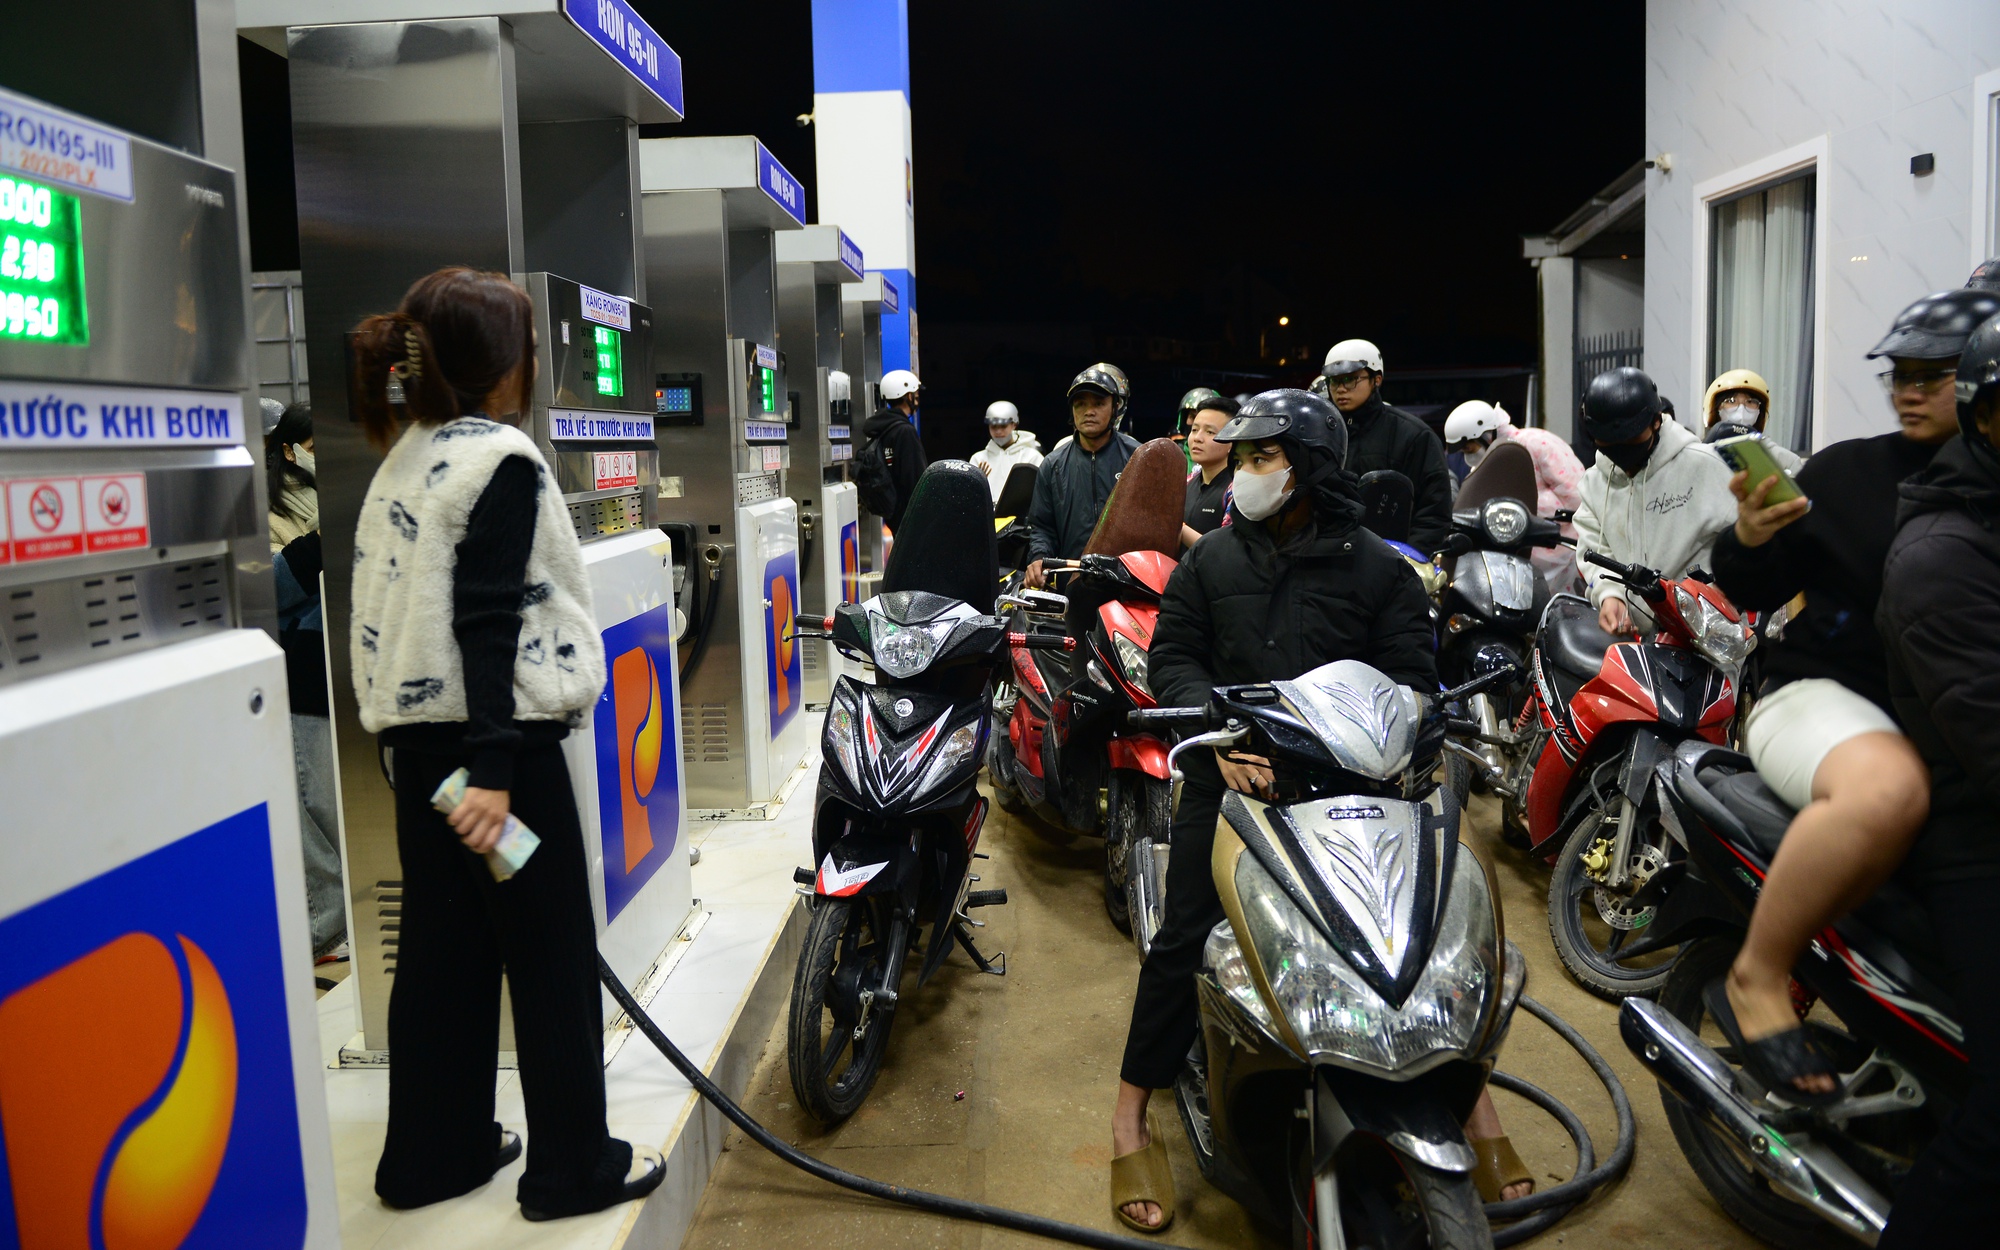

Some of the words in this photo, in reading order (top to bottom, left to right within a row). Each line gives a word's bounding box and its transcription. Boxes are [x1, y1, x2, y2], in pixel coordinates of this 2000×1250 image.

[597, 0, 626, 51] RON
[627, 21, 659, 82] 95-III
[101, 404, 155, 439] KHI
[166, 402, 230, 439] BƠM
[556, 413, 574, 437] TRẢ
[575, 414, 587, 437] VỀ
[596, 417, 621, 437] TRƯỚC
[622, 421, 635, 437] KHI
[636, 421, 652, 438] BƠM
